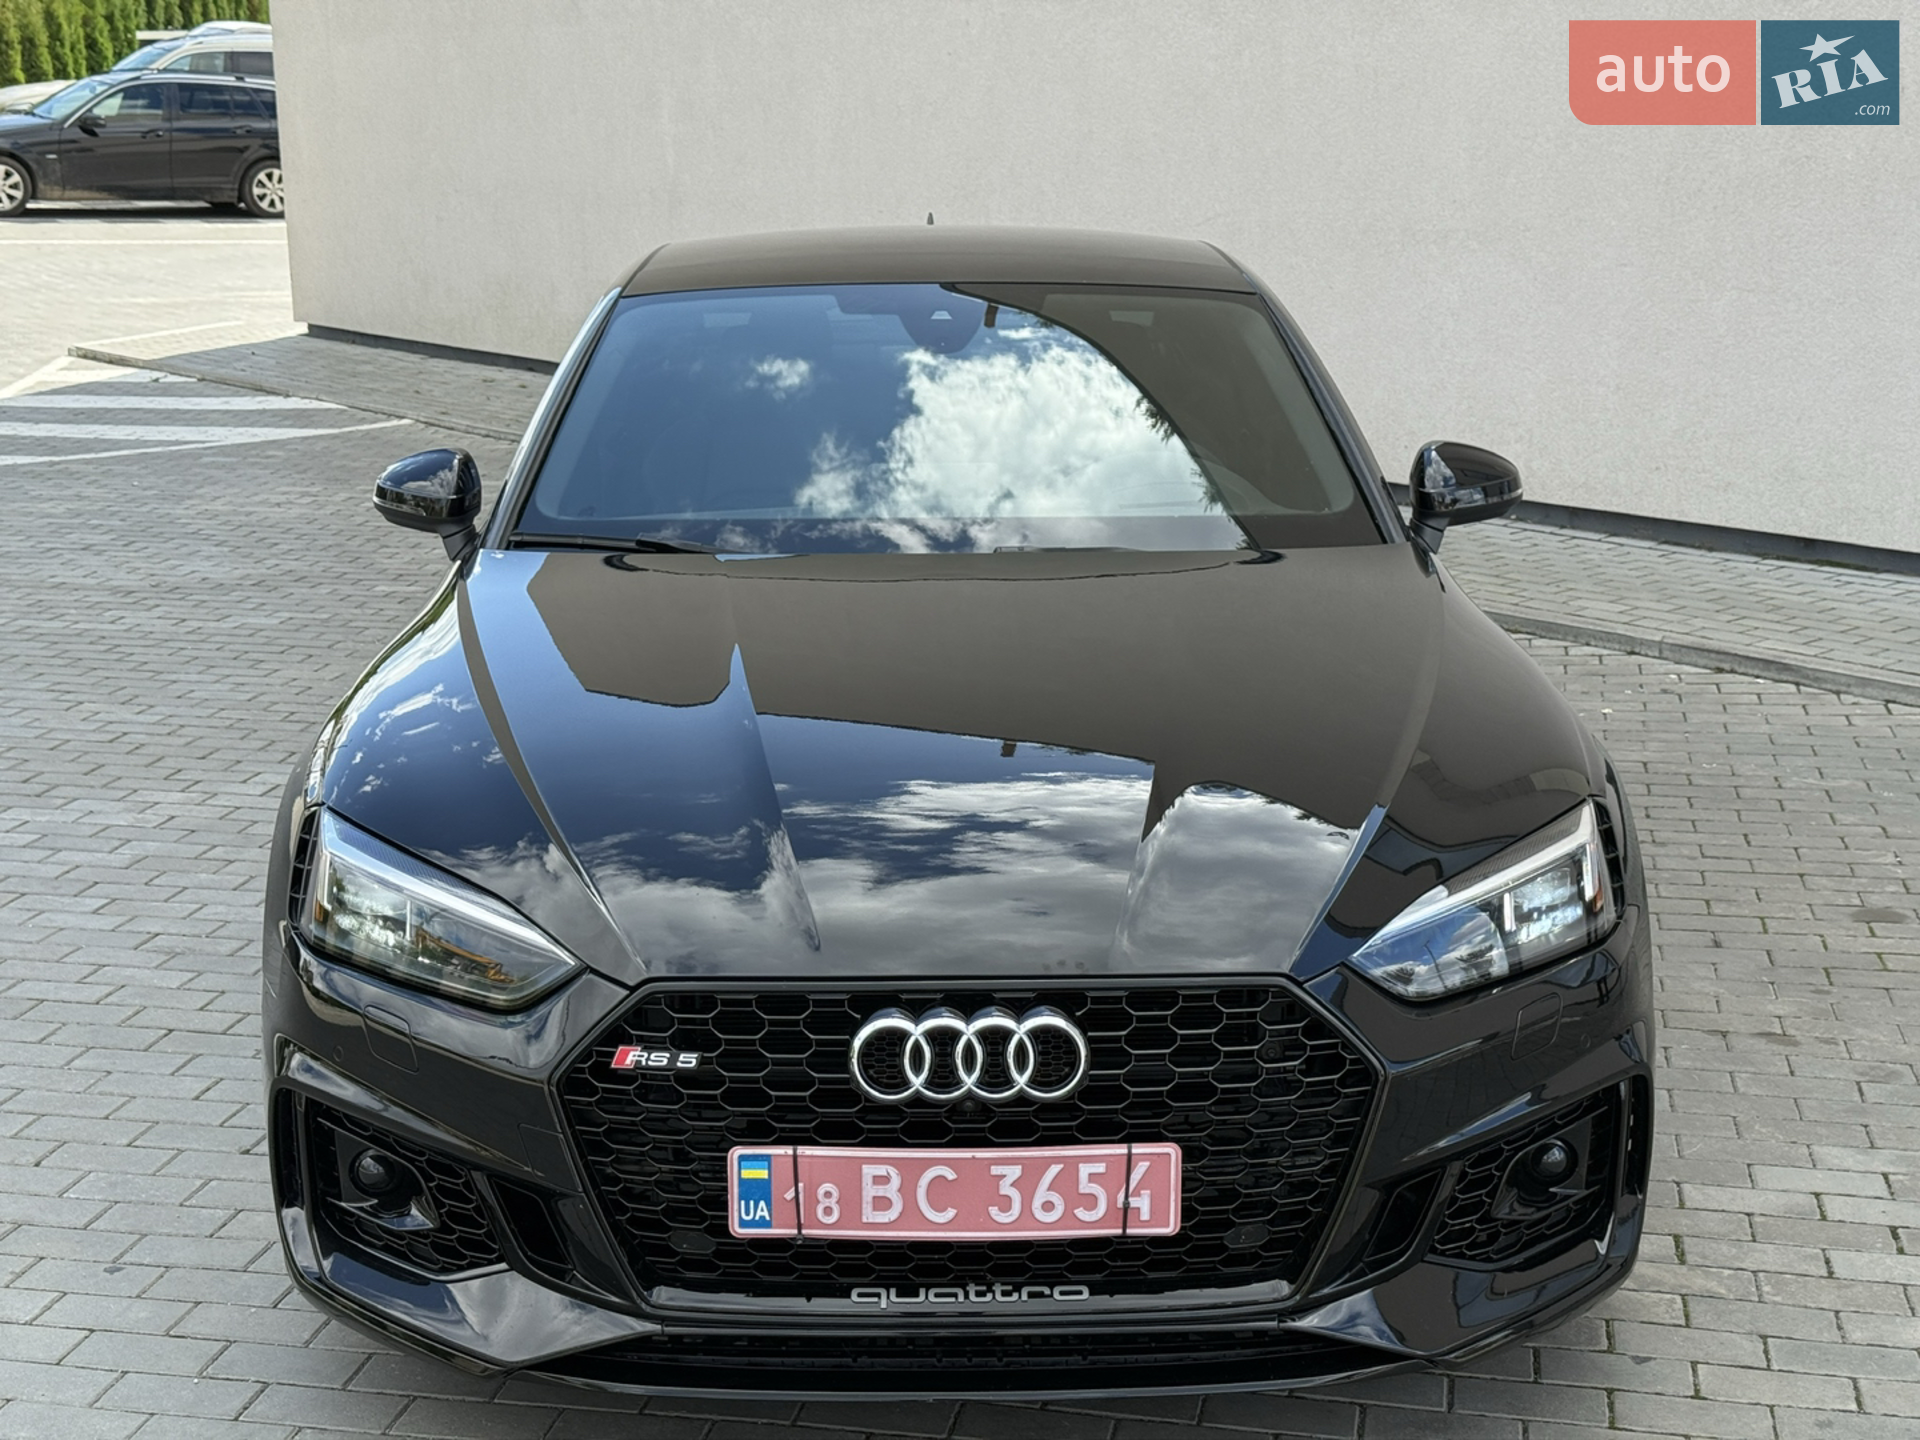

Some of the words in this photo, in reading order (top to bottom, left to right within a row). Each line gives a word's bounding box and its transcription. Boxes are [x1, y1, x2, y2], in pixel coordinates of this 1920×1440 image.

[625, 1052, 670, 1066] RS
[676, 1053, 699, 1068] 5
[784, 1183, 841, 1225] 18
[861, 1164, 958, 1224] BC
[988, 1161, 1152, 1223] 3654
[740, 1200, 771, 1221] UA
[850, 1283, 1090, 1309] quattro
